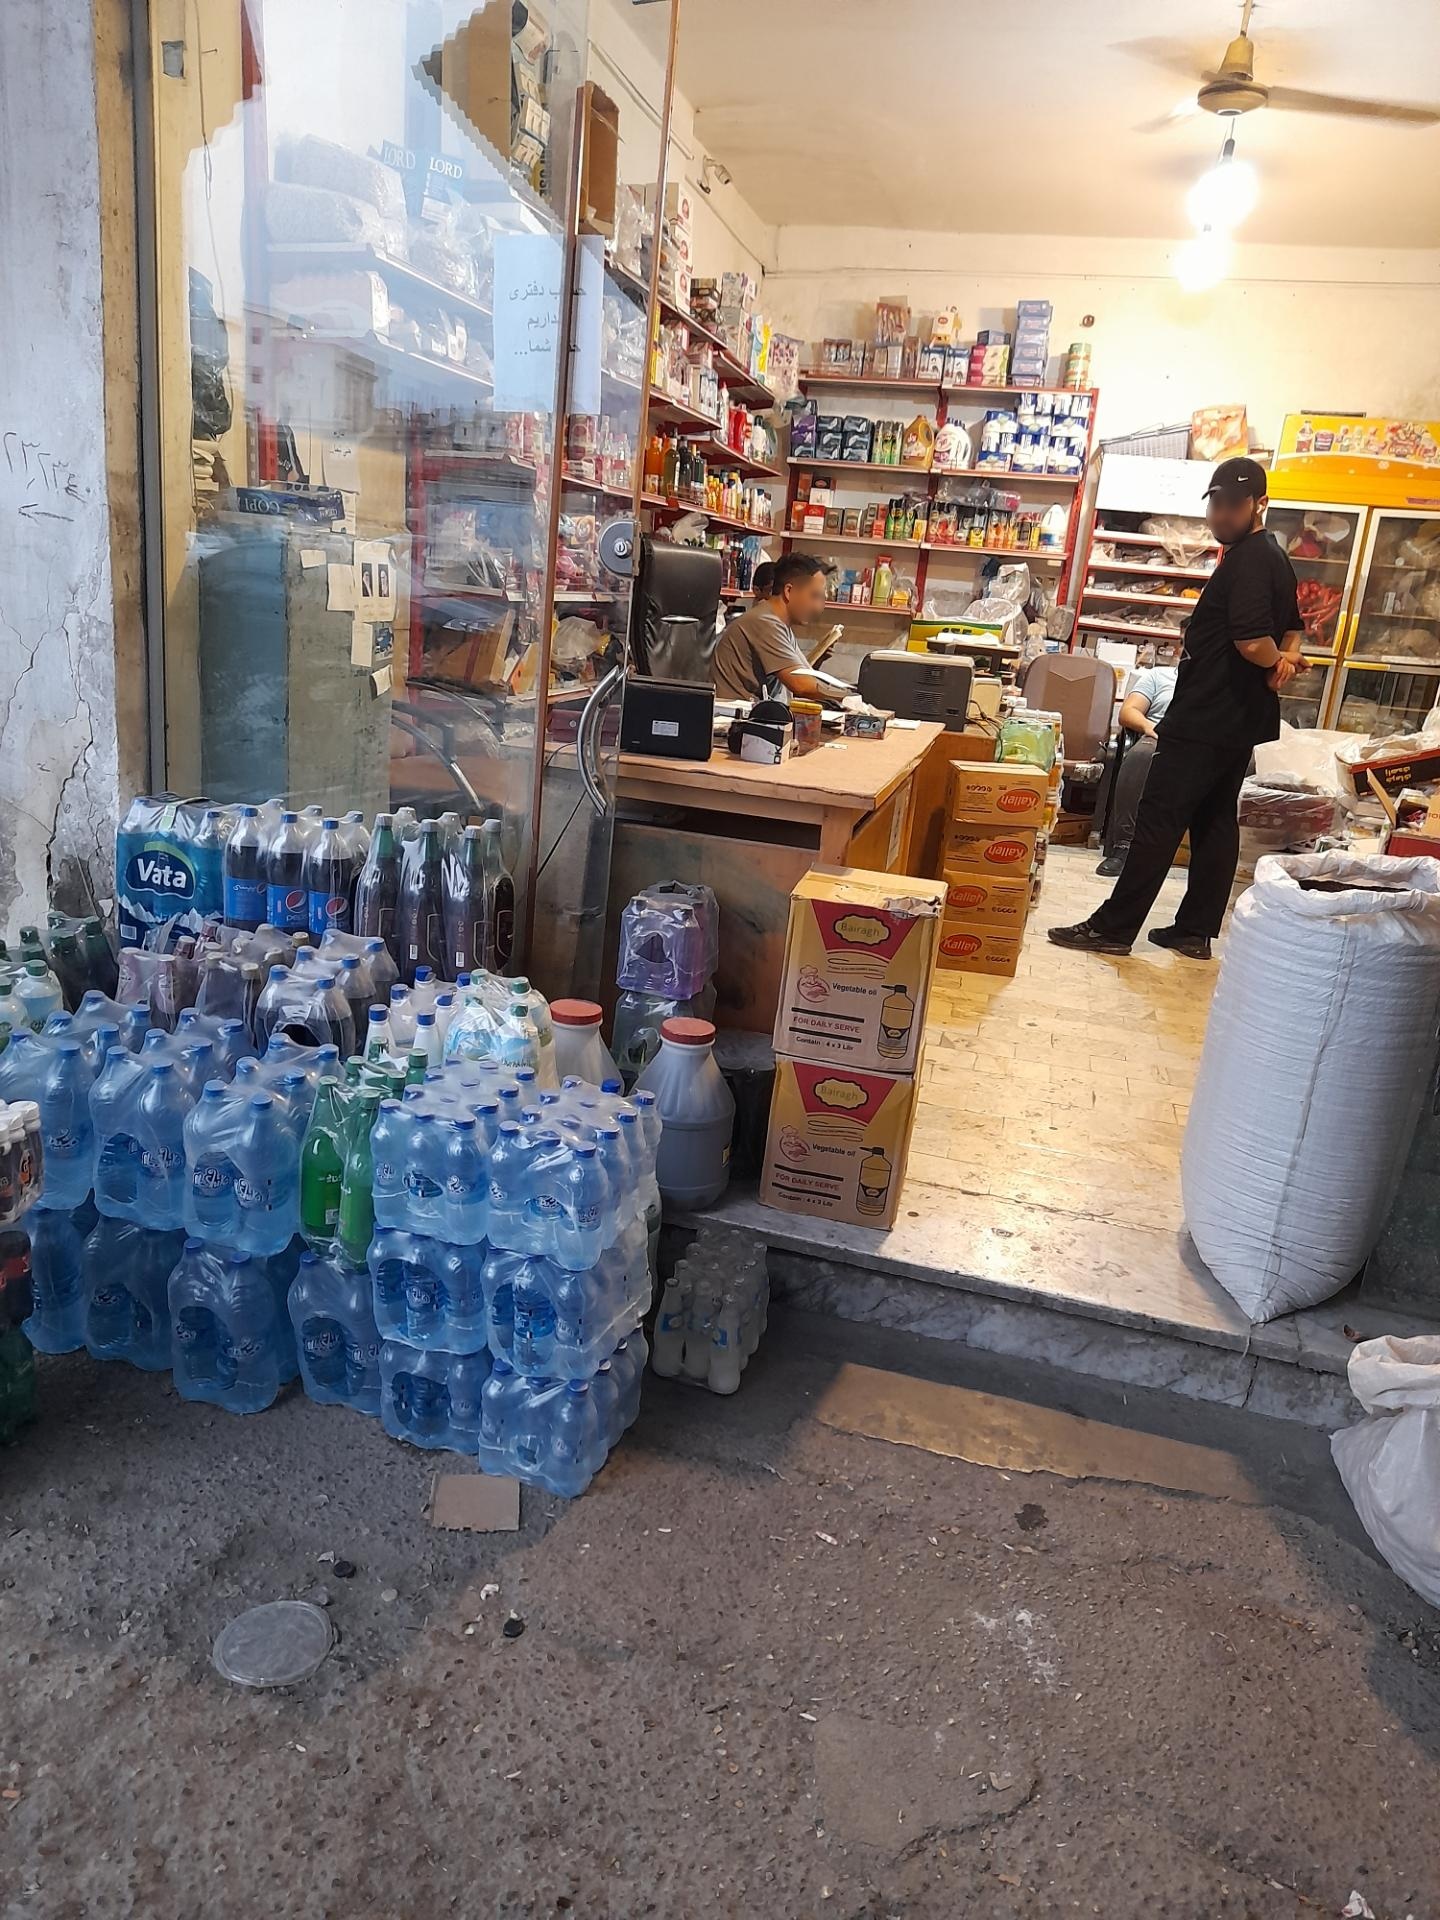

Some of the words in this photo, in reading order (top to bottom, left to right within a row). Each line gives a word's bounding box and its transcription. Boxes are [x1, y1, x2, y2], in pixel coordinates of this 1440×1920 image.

[383, 146, 416, 169] LORD
[429, 156, 463, 180] LORD
[509, 281, 544, 300] دفتری
[527, 312, 561, 330] داریم
[1001, 795, 1037, 808] Kalleh
[988, 845, 1025, 858] Kalleh
[137, 858, 187, 889] Vata
[948, 890, 984, 903] Kalleh
[840, 922, 881, 938] Bairagh
[943, 939, 978, 952] Kalleh
[832, 982, 867, 995] Vegetable
[793, 1016, 809, 1025] FOR
[810, 1018, 833, 1029] DAILY
[834, 1023, 862, 1034] SERVE
[821, 1086, 858, 1101] Bairagh
[812, 1143, 846, 1155] Vegetable
[775, 1172, 790, 1182] FOR
[791, 1177, 814, 1188] DAILY
[815, 1182, 840, 1191] SERVE
